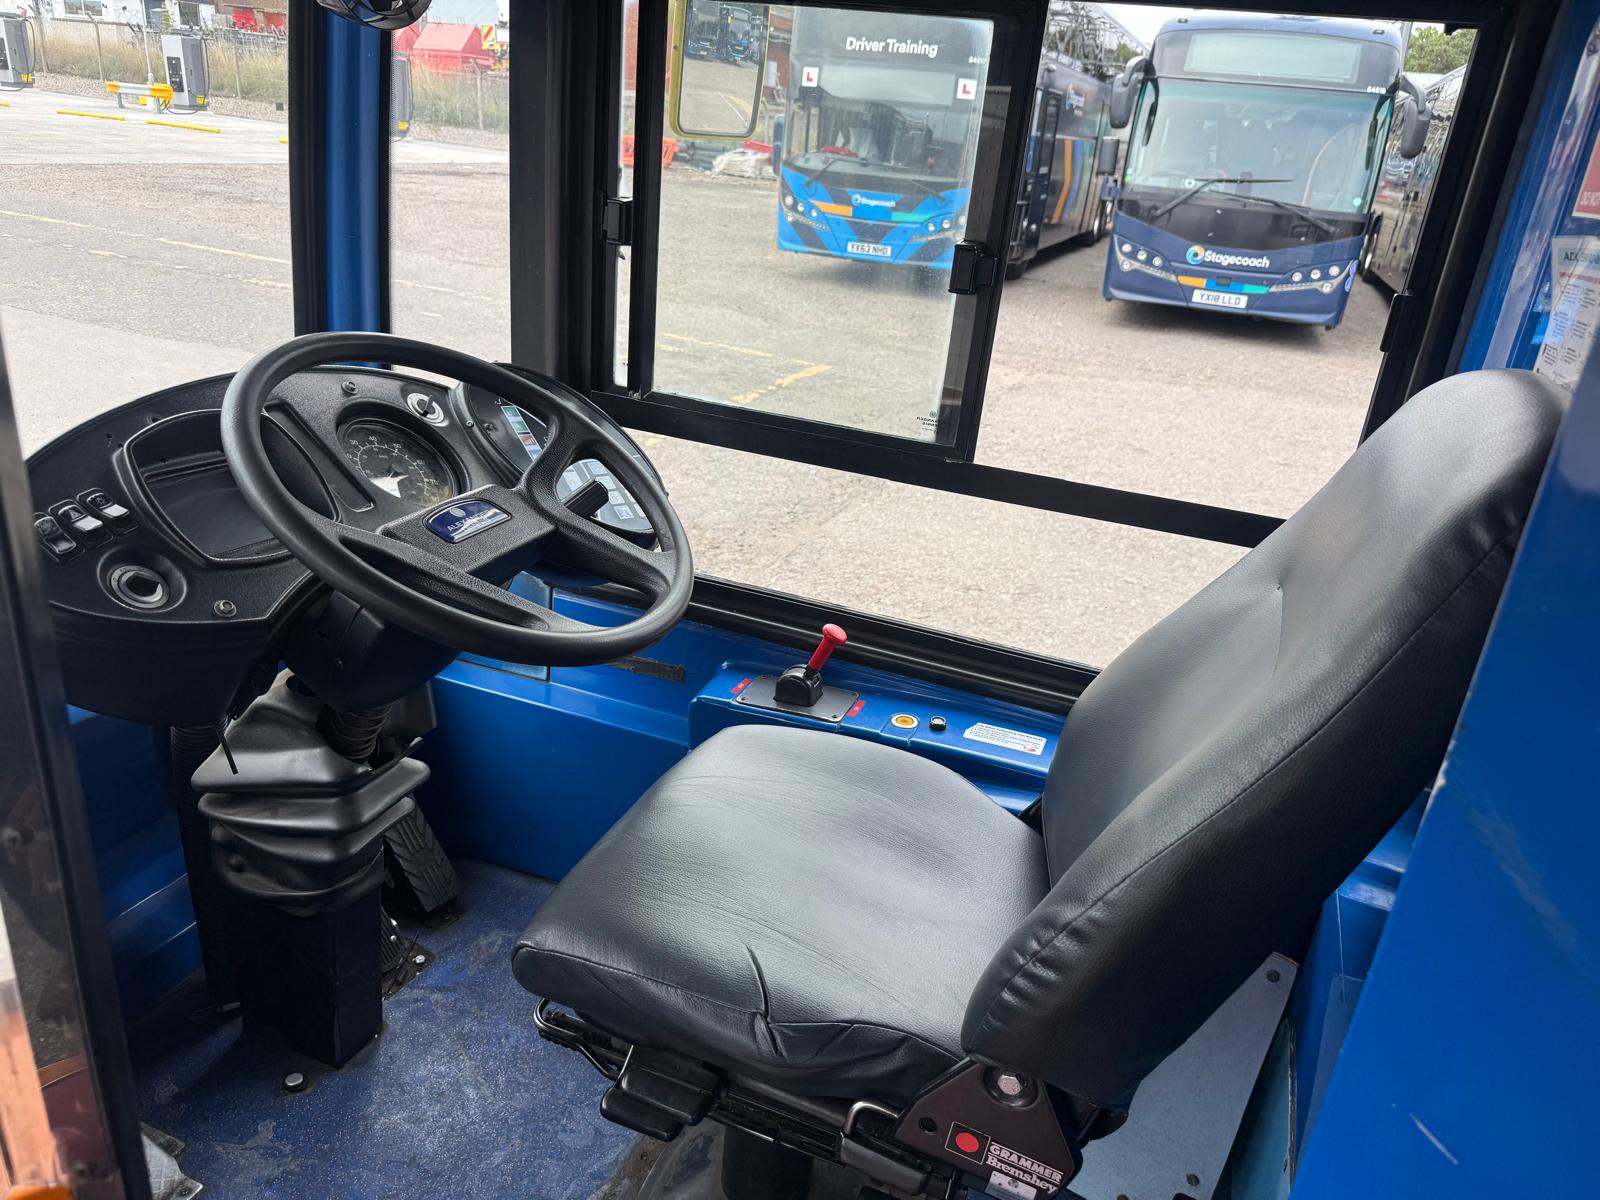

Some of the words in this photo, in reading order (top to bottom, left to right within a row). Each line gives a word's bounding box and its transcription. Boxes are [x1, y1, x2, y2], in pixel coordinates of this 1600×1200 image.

[846, 36, 885, 52] Driver
[887, 37, 939, 59] Training
[1204, 250, 1270, 269] Stagecoach
[1199, 292, 1220, 303] YX18
[986, 1154, 1058, 1194] Bremshey
[989, 1144, 1062, 1183] GRAMMER
